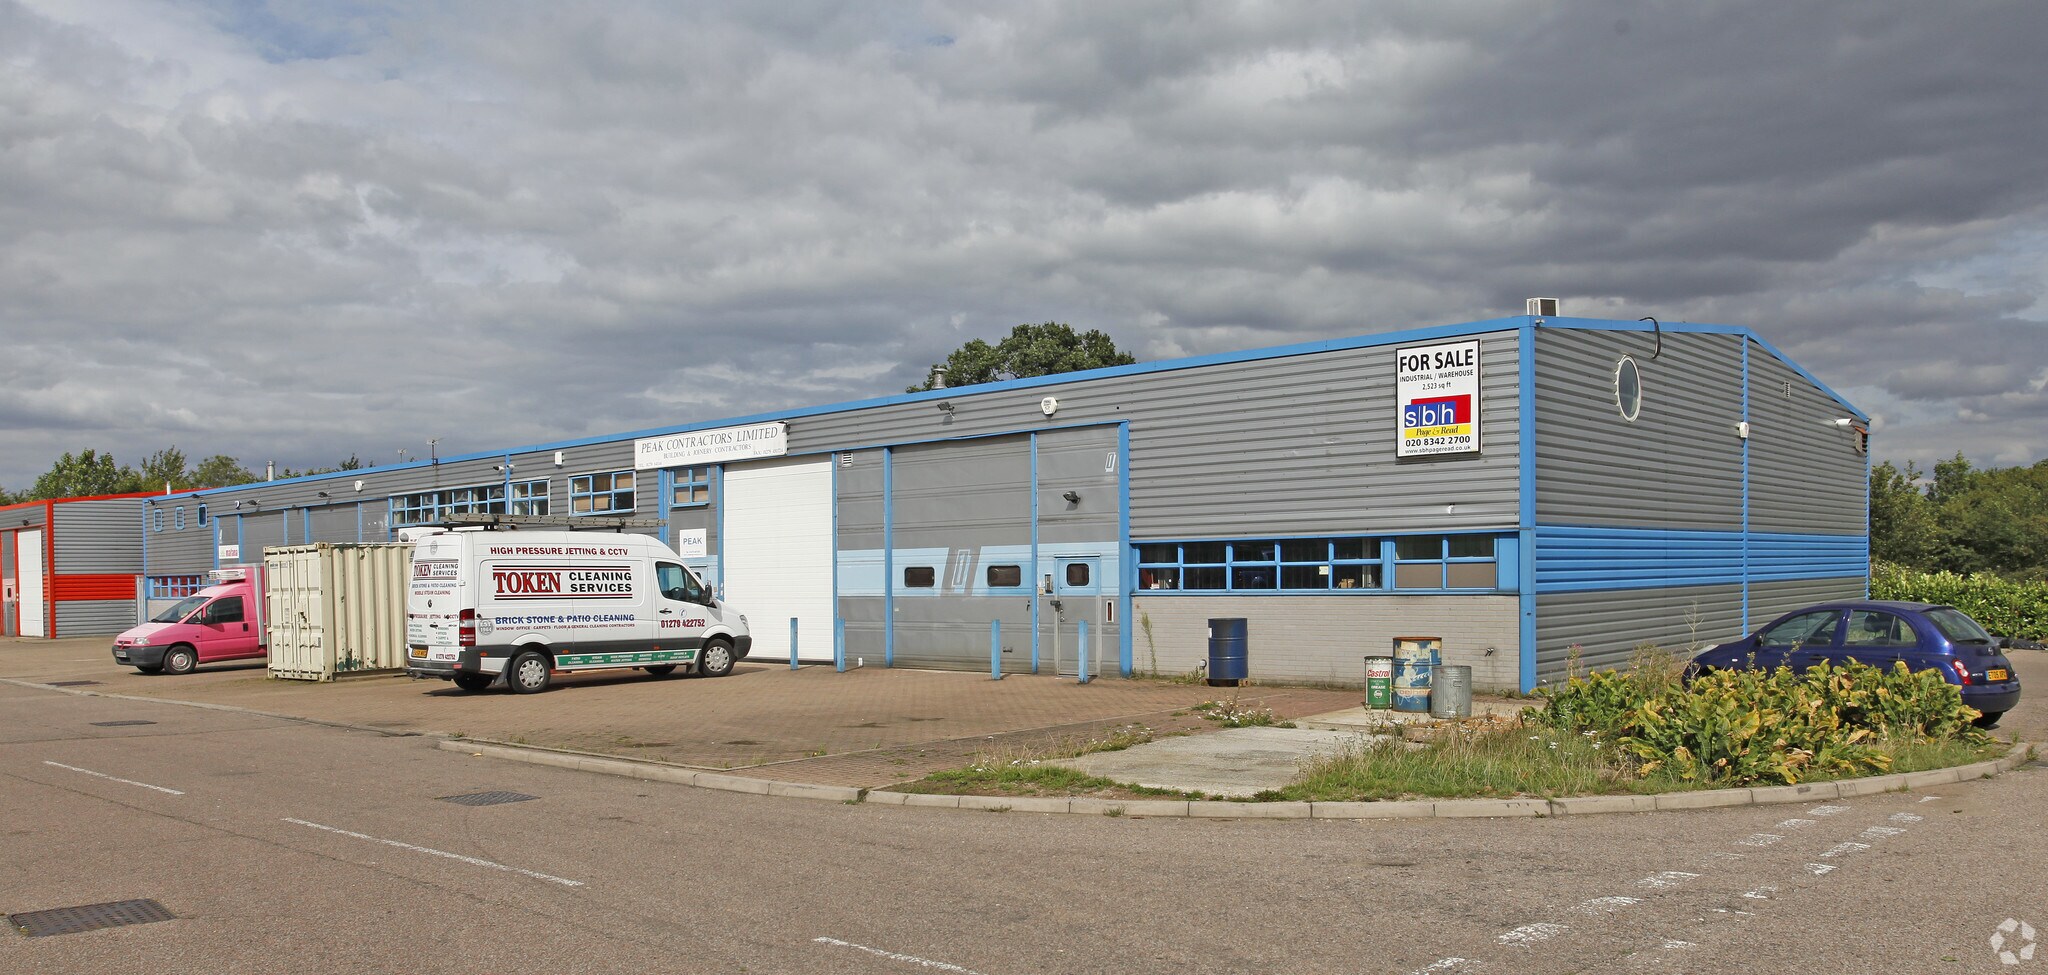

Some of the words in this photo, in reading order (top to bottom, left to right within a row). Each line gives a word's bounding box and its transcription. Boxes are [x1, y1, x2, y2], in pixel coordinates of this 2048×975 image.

[1400, 354, 1430, 372] FOR
[1435, 349, 1474, 369] SALE
[1400, 374, 1433, 382] INDUSTRIAL
[1438, 369, 1474, 379] WAREHOUSE
[1405, 404, 1454, 427] sbh
[1416, 428, 1432, 437] Page
[1441, 426, 1459, 434] Read
[641, 440, 664, 454] PEAK
[666, 431, 733, 451] CONTRACTORS
[736, 426, 778, 442] LIMITED
[1405, 439, 1421, 447] 020
[1424, 437, 1445, 446] 8342
[1448, 435, 1471, 444] 2700
[663, 450, 686, 459] BUILDING
[693, 448, 712, 457] JOINERY
[714, 444, 752, 454] CONTRACTORS
[683, 537, 702, 545] PEAK
[490, 547, 513, 555] HIGH
[516, 547, 563, 555] PRESSURE
[565, 547, 597, 555] JETTING
[607, 548, 628, 556] CCTV
[414, 564, 432, 576] TOKEN
[569, 572, 632, 581] CLEANING
[492, 572, 561, 593] TOKEN
[570, 583, 632, 592] SERVICES
[495, 616, 524, 625] BRICK
[526, 615, 555, 624] STONE
[558, 615, 564, 623] &
[567, 615, 591, 623] PATIO
[593, 614, 635, 622] CLEANING
[682, 619, 705, 627] 422752
[1367, 669, 1390, 678] Castrol
